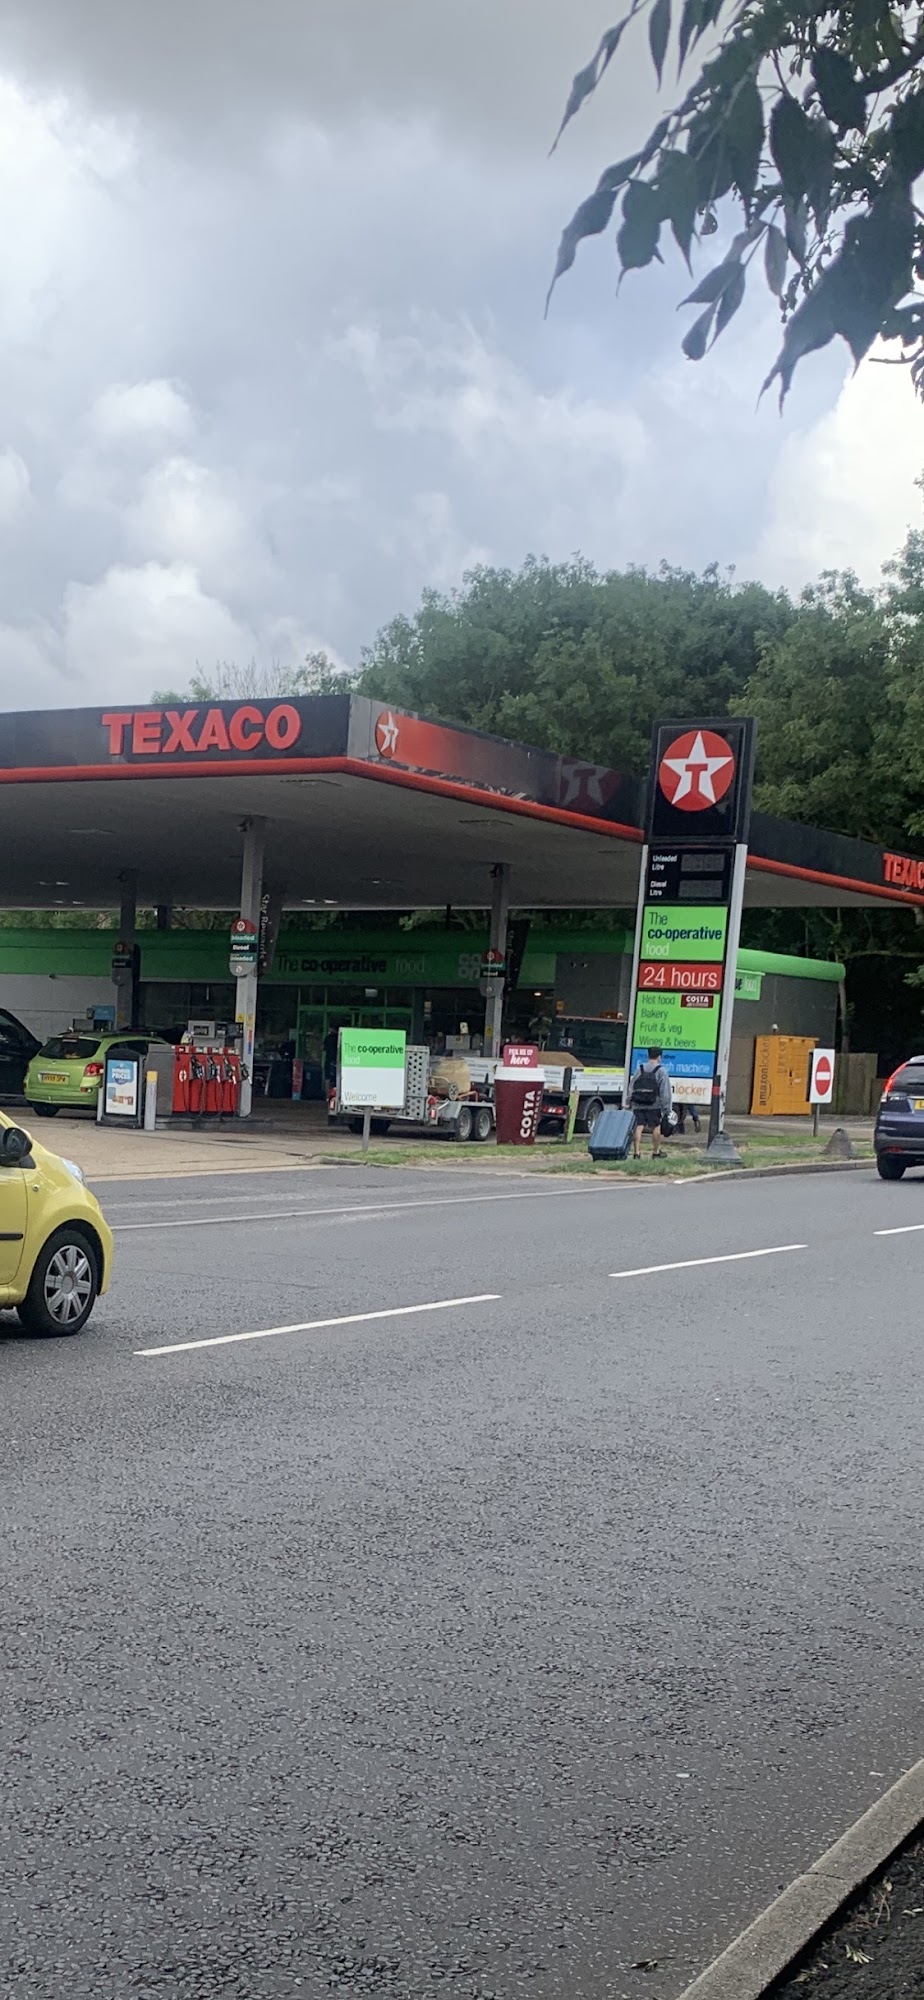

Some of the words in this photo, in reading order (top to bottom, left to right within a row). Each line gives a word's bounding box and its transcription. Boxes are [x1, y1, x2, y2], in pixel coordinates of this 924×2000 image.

[101, 704, 302, 756] TEXACO
[652, 854, 678, 863] Unleaded
[651, 863, 665, 871] Litre
[650, 880, 668, 888] Diesel
[649, 912, 668, 926] The
[647, 925, 723, 942] co-operative
[644, 942, 671, 957] food
[278, 954, 298, 972] The
[301, 954, 387, 975] co-operative
[395, 956, 425, 974] food
[643, 966, 666, 986] 24
[671, 966, 718, 989] hours
[642, 994, 656, 1005] Hot
[657, 995, 676, 1006] food
[685, 995, 709, 1003] COSTA
[641, 1008, 669, 1020] Bakery
[639, 1022, 658, 1034] Fruit
[660, 1022, 667, 1033] &
[668, 1026, 683, 1036] veg
[638, 1035, 663, 1047] Wines
[664, 1036, 673, 1048] &
[674, 1038, 697, 1048] beers
[344, 1043, 357, 1053] The
[357, 1044, 404, 1056] co-operative
[344, 1055, 361, 1064] food
[676, 1062, 710, 1074] machine
[344, 1091, 378, 1102] Welcome
[519, 1090, 536, 1138] COSTA
